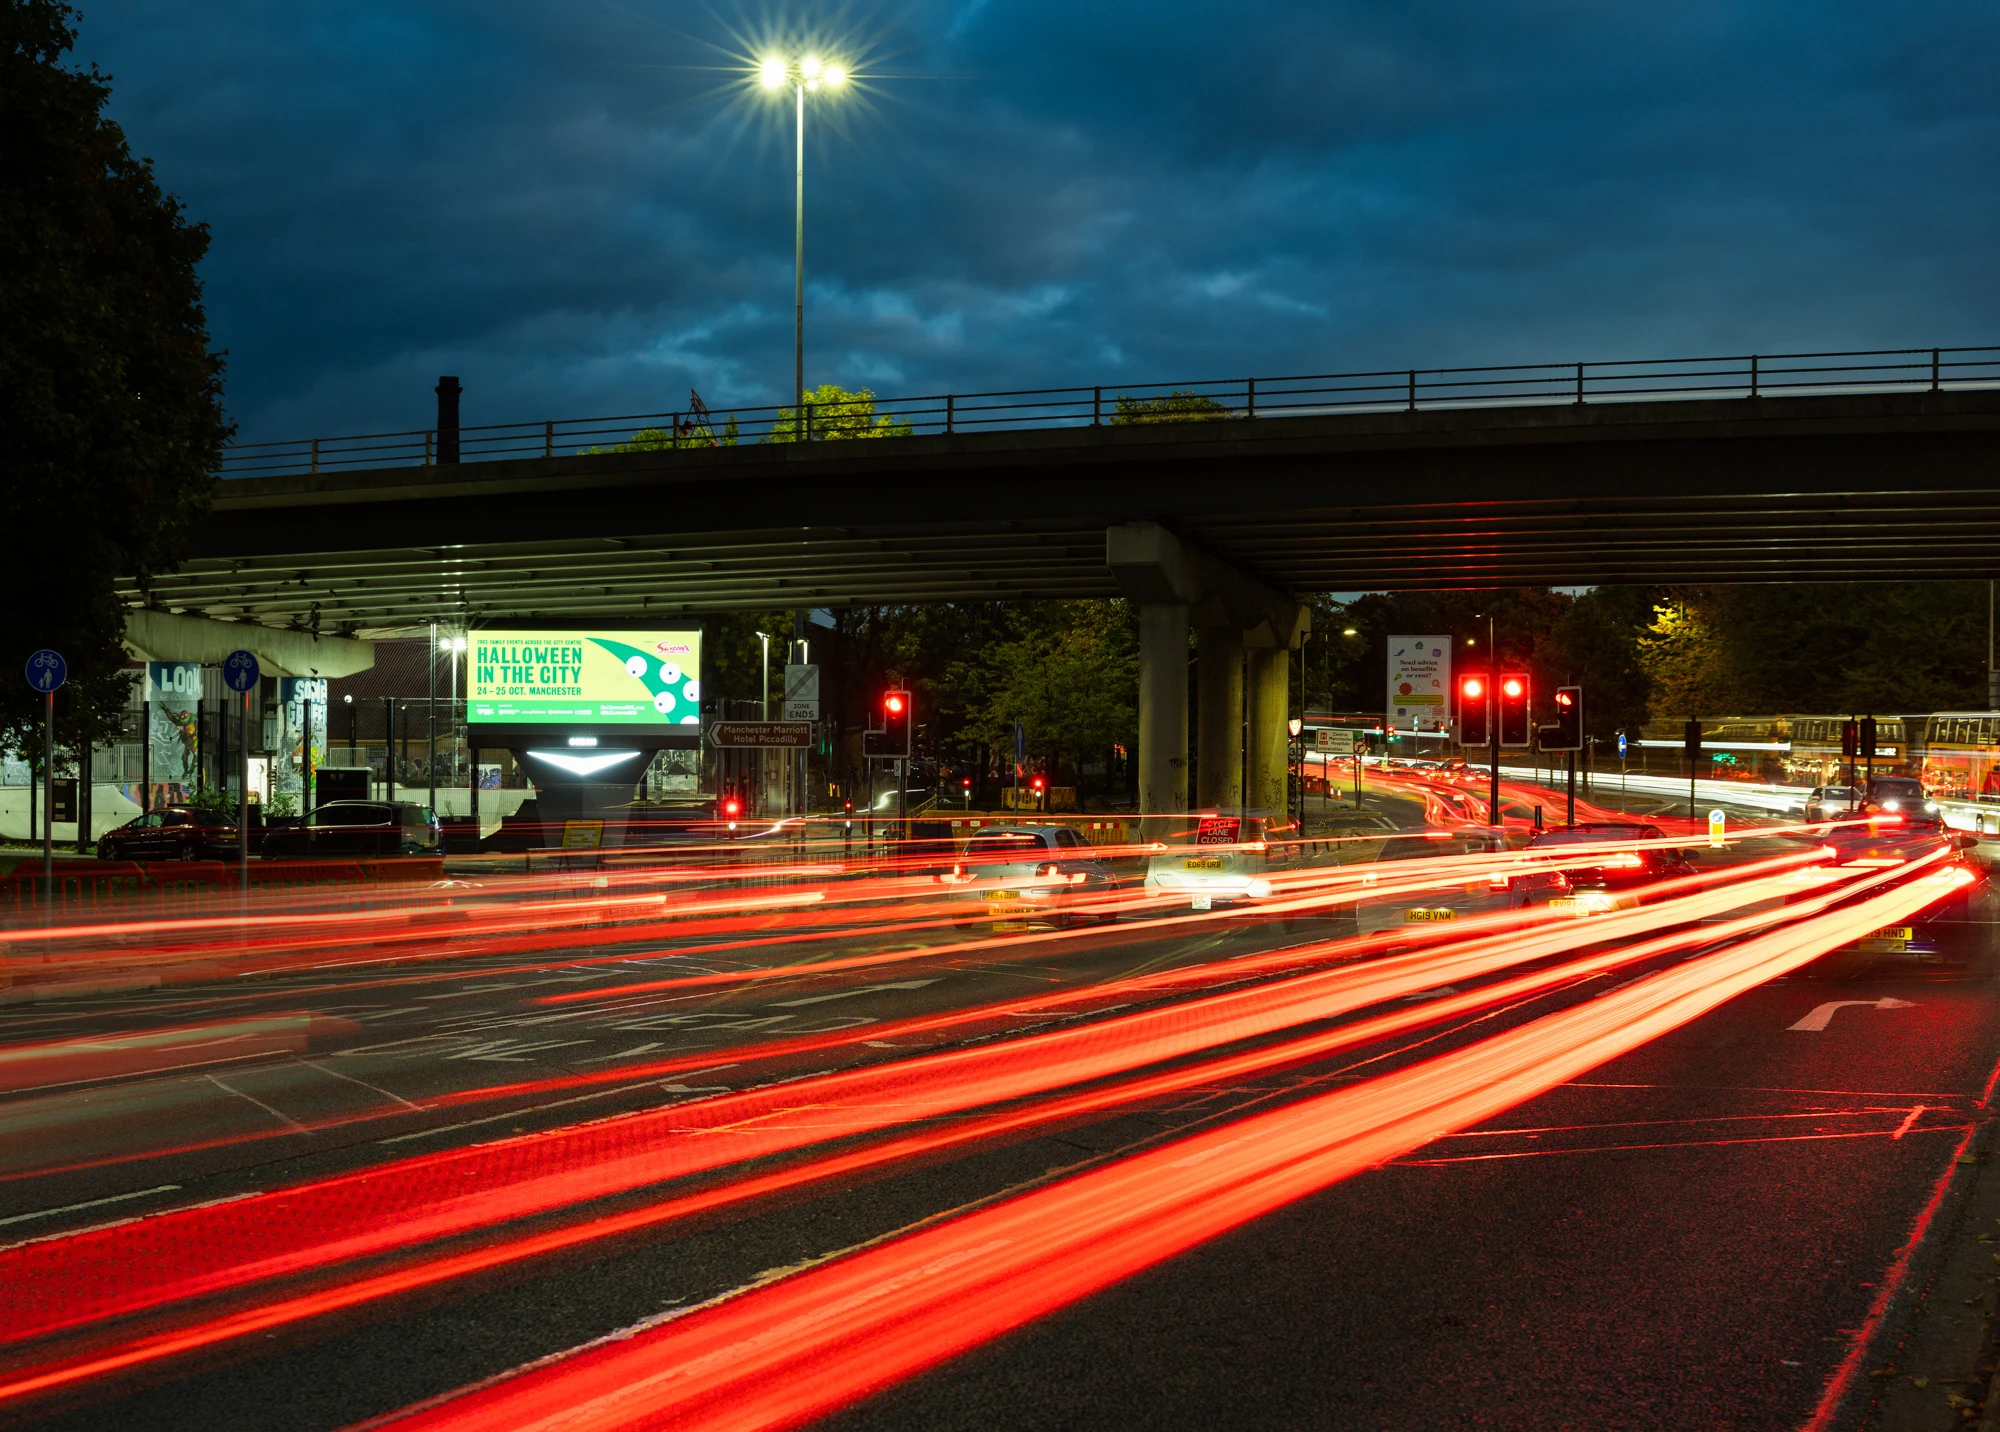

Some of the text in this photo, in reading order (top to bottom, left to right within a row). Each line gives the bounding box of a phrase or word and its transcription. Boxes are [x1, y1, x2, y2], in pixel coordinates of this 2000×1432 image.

[477, 647, 582, 664] HALLOWEEN
[477, 666, 582, 684] IN THE CITY
[161, 665, 201, 696] LOOK
[477, 687, 487, 695] 24
[496, 687, 506, 695] 25
[509, 687, 526, 695] OCT.
[529, 687, 582, 695] MANCHESTER
[789, 710, 814, 719] ENDS
[723, 726, 808, 734] Manchester Marriott
[733, 735, 798, 744] Hotel Piccadilly
[1206, 820, 1234, 828] CYCLE
[1200, 836, 1234, 844] CLOSED
[1410, 911, 1451, 920] HG19 VNM
[1883, 929, 1905, 938] HND
